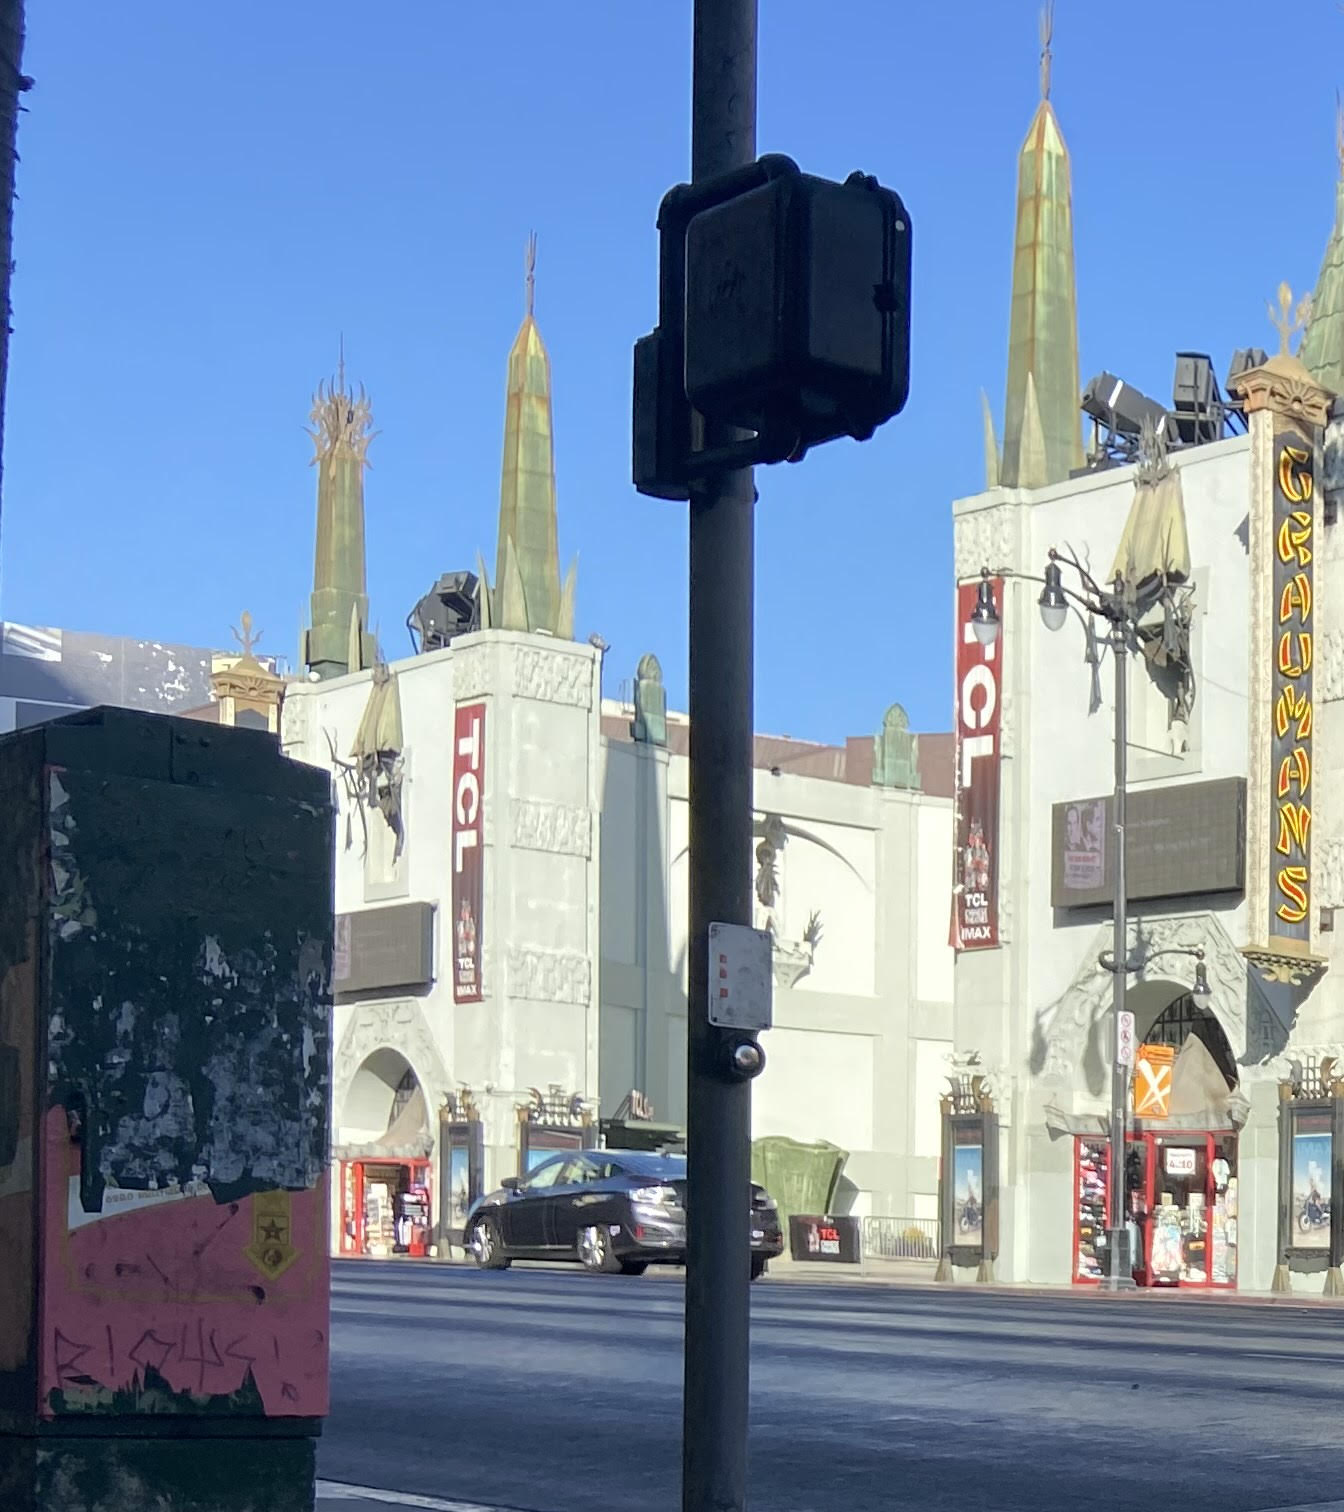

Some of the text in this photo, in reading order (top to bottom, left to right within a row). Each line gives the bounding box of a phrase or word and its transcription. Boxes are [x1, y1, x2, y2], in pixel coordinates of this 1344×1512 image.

[1275, 445, 1314, 925] GRAUMANS
[455, 717, 481, 873] TCL
[960, 925, 992, 941] IMAX
[964, 892, 989, 908] TCL
